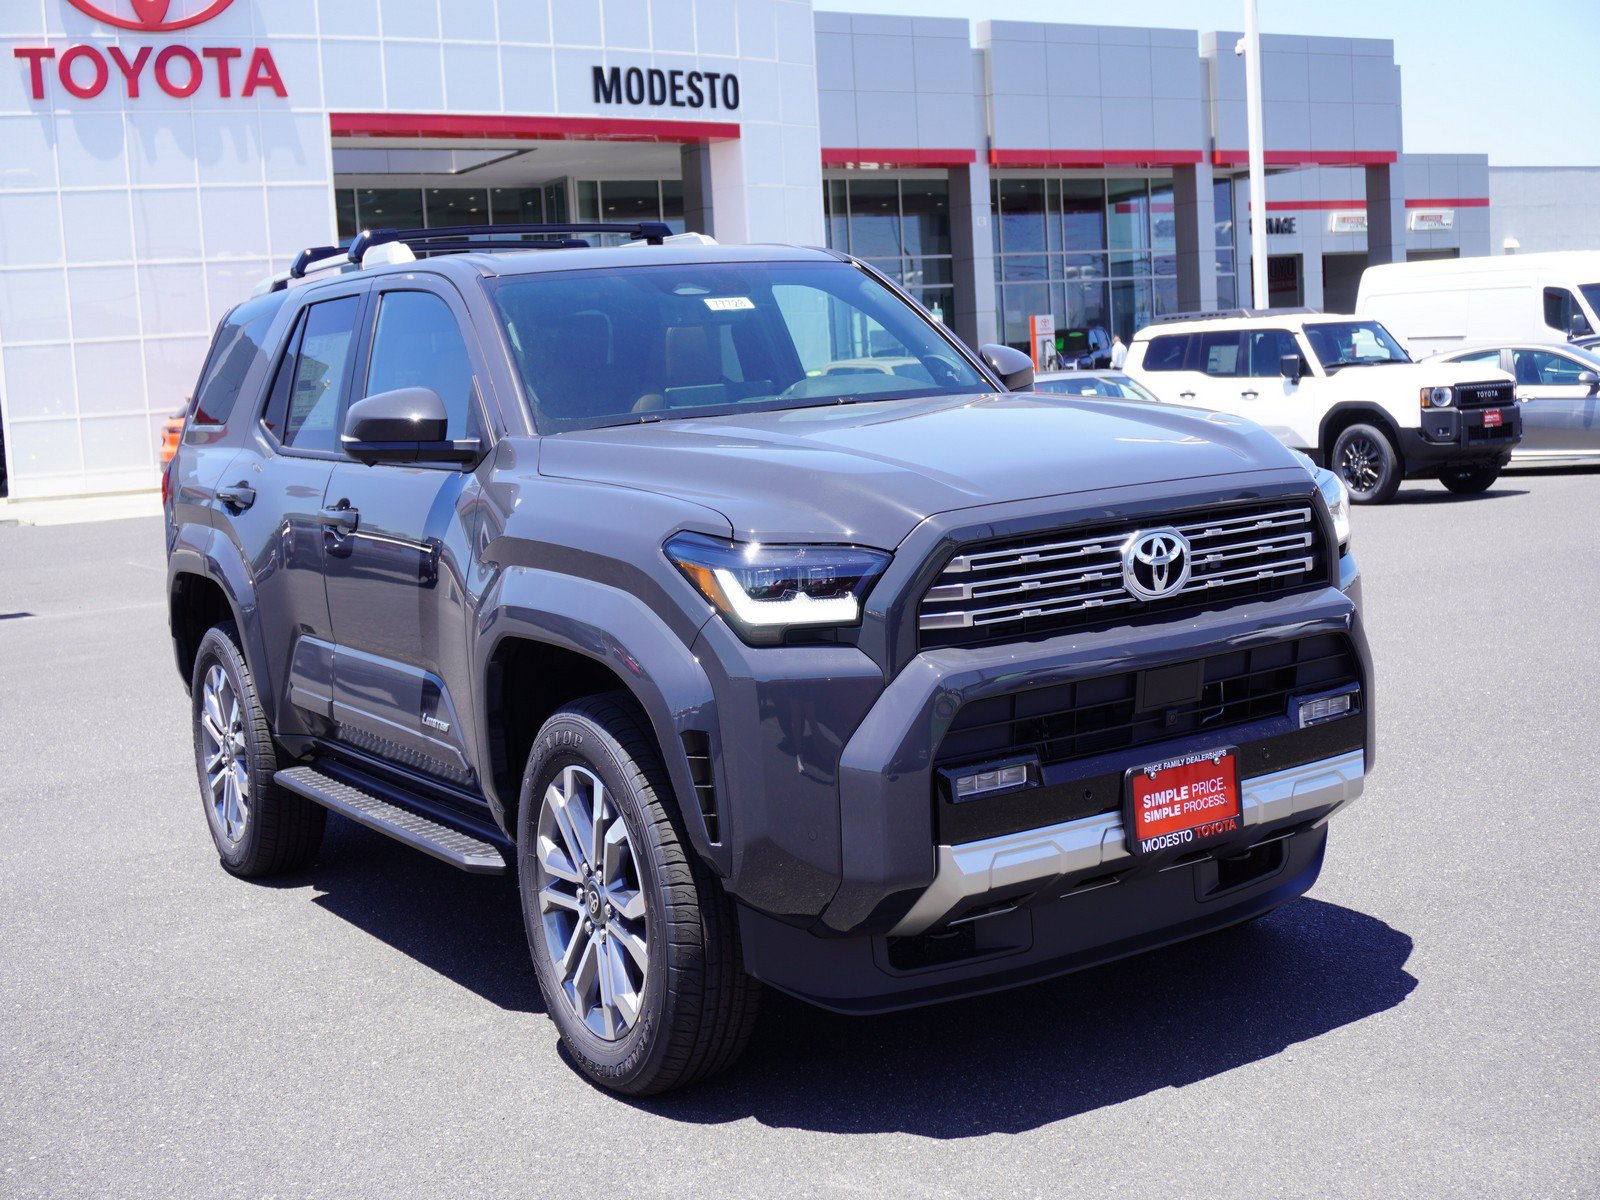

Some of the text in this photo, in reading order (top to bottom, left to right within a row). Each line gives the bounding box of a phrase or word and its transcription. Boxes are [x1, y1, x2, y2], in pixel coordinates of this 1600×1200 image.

[14, 44, 288, 99] TOYOTA
[592, 66, 740, 110] MODESTO
[1477, 390, 1498, 398] TOYOTA
[1143, 749, 1227, 774] PRICE FAMILY DEALERSHIPS
[1143, 777, 1227, 808] SIMPLE PRICE.
[1144, 793, 1228, 823] SIMPLE PROCESS.
[1142, 819, 1237, 853] MODESTO TOYOTA
